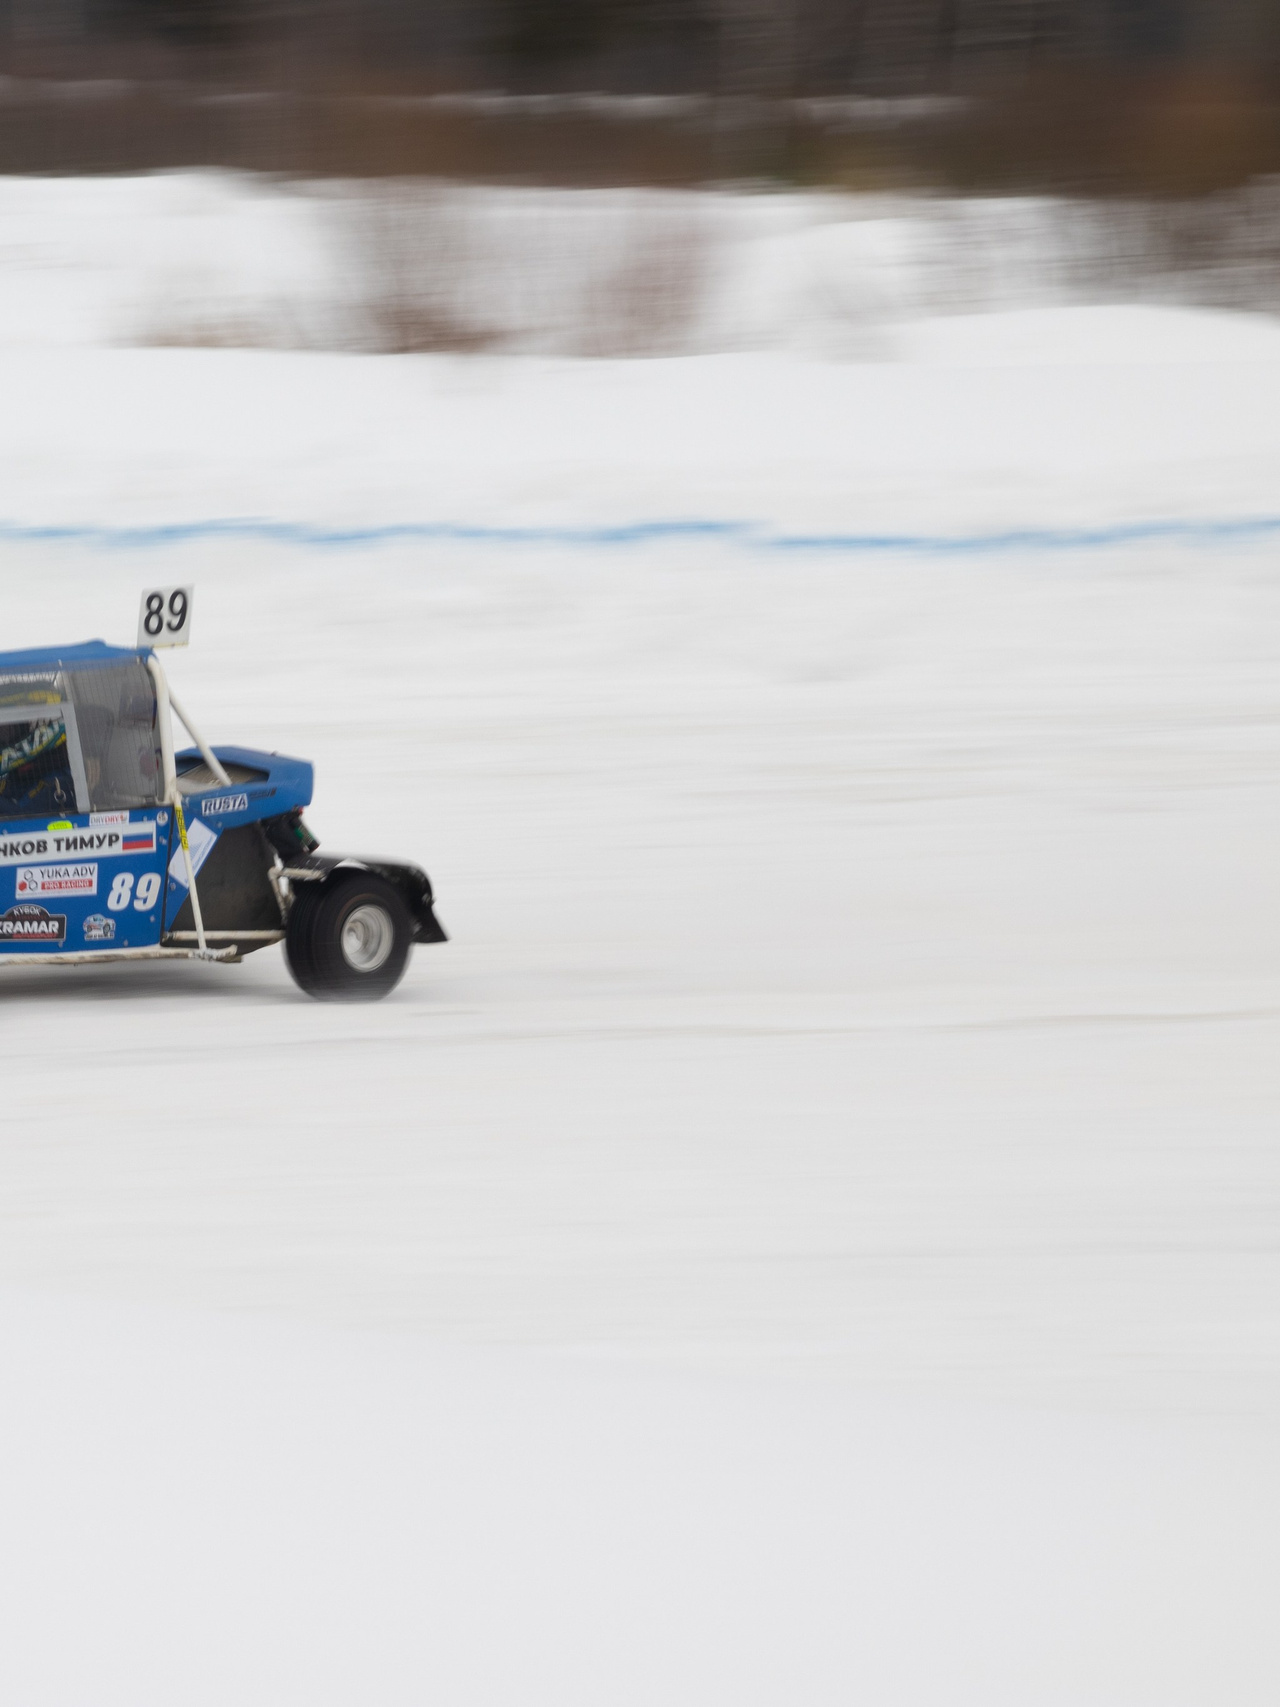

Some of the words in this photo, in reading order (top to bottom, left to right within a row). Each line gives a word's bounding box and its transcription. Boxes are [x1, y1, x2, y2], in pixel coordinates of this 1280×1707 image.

[144, 589, 188, 636] 89
[203, 795, 247, 813] RUSTA
[53, 832, 120, 853] ТИМУР
[39, 867, 70, 879] YUKA
[72, 865, 96, 877] ADV
[44, 881, 60, 890] PRO
[61, 879, 90, 889] RACING
[107, 871, 162, 912] 89
